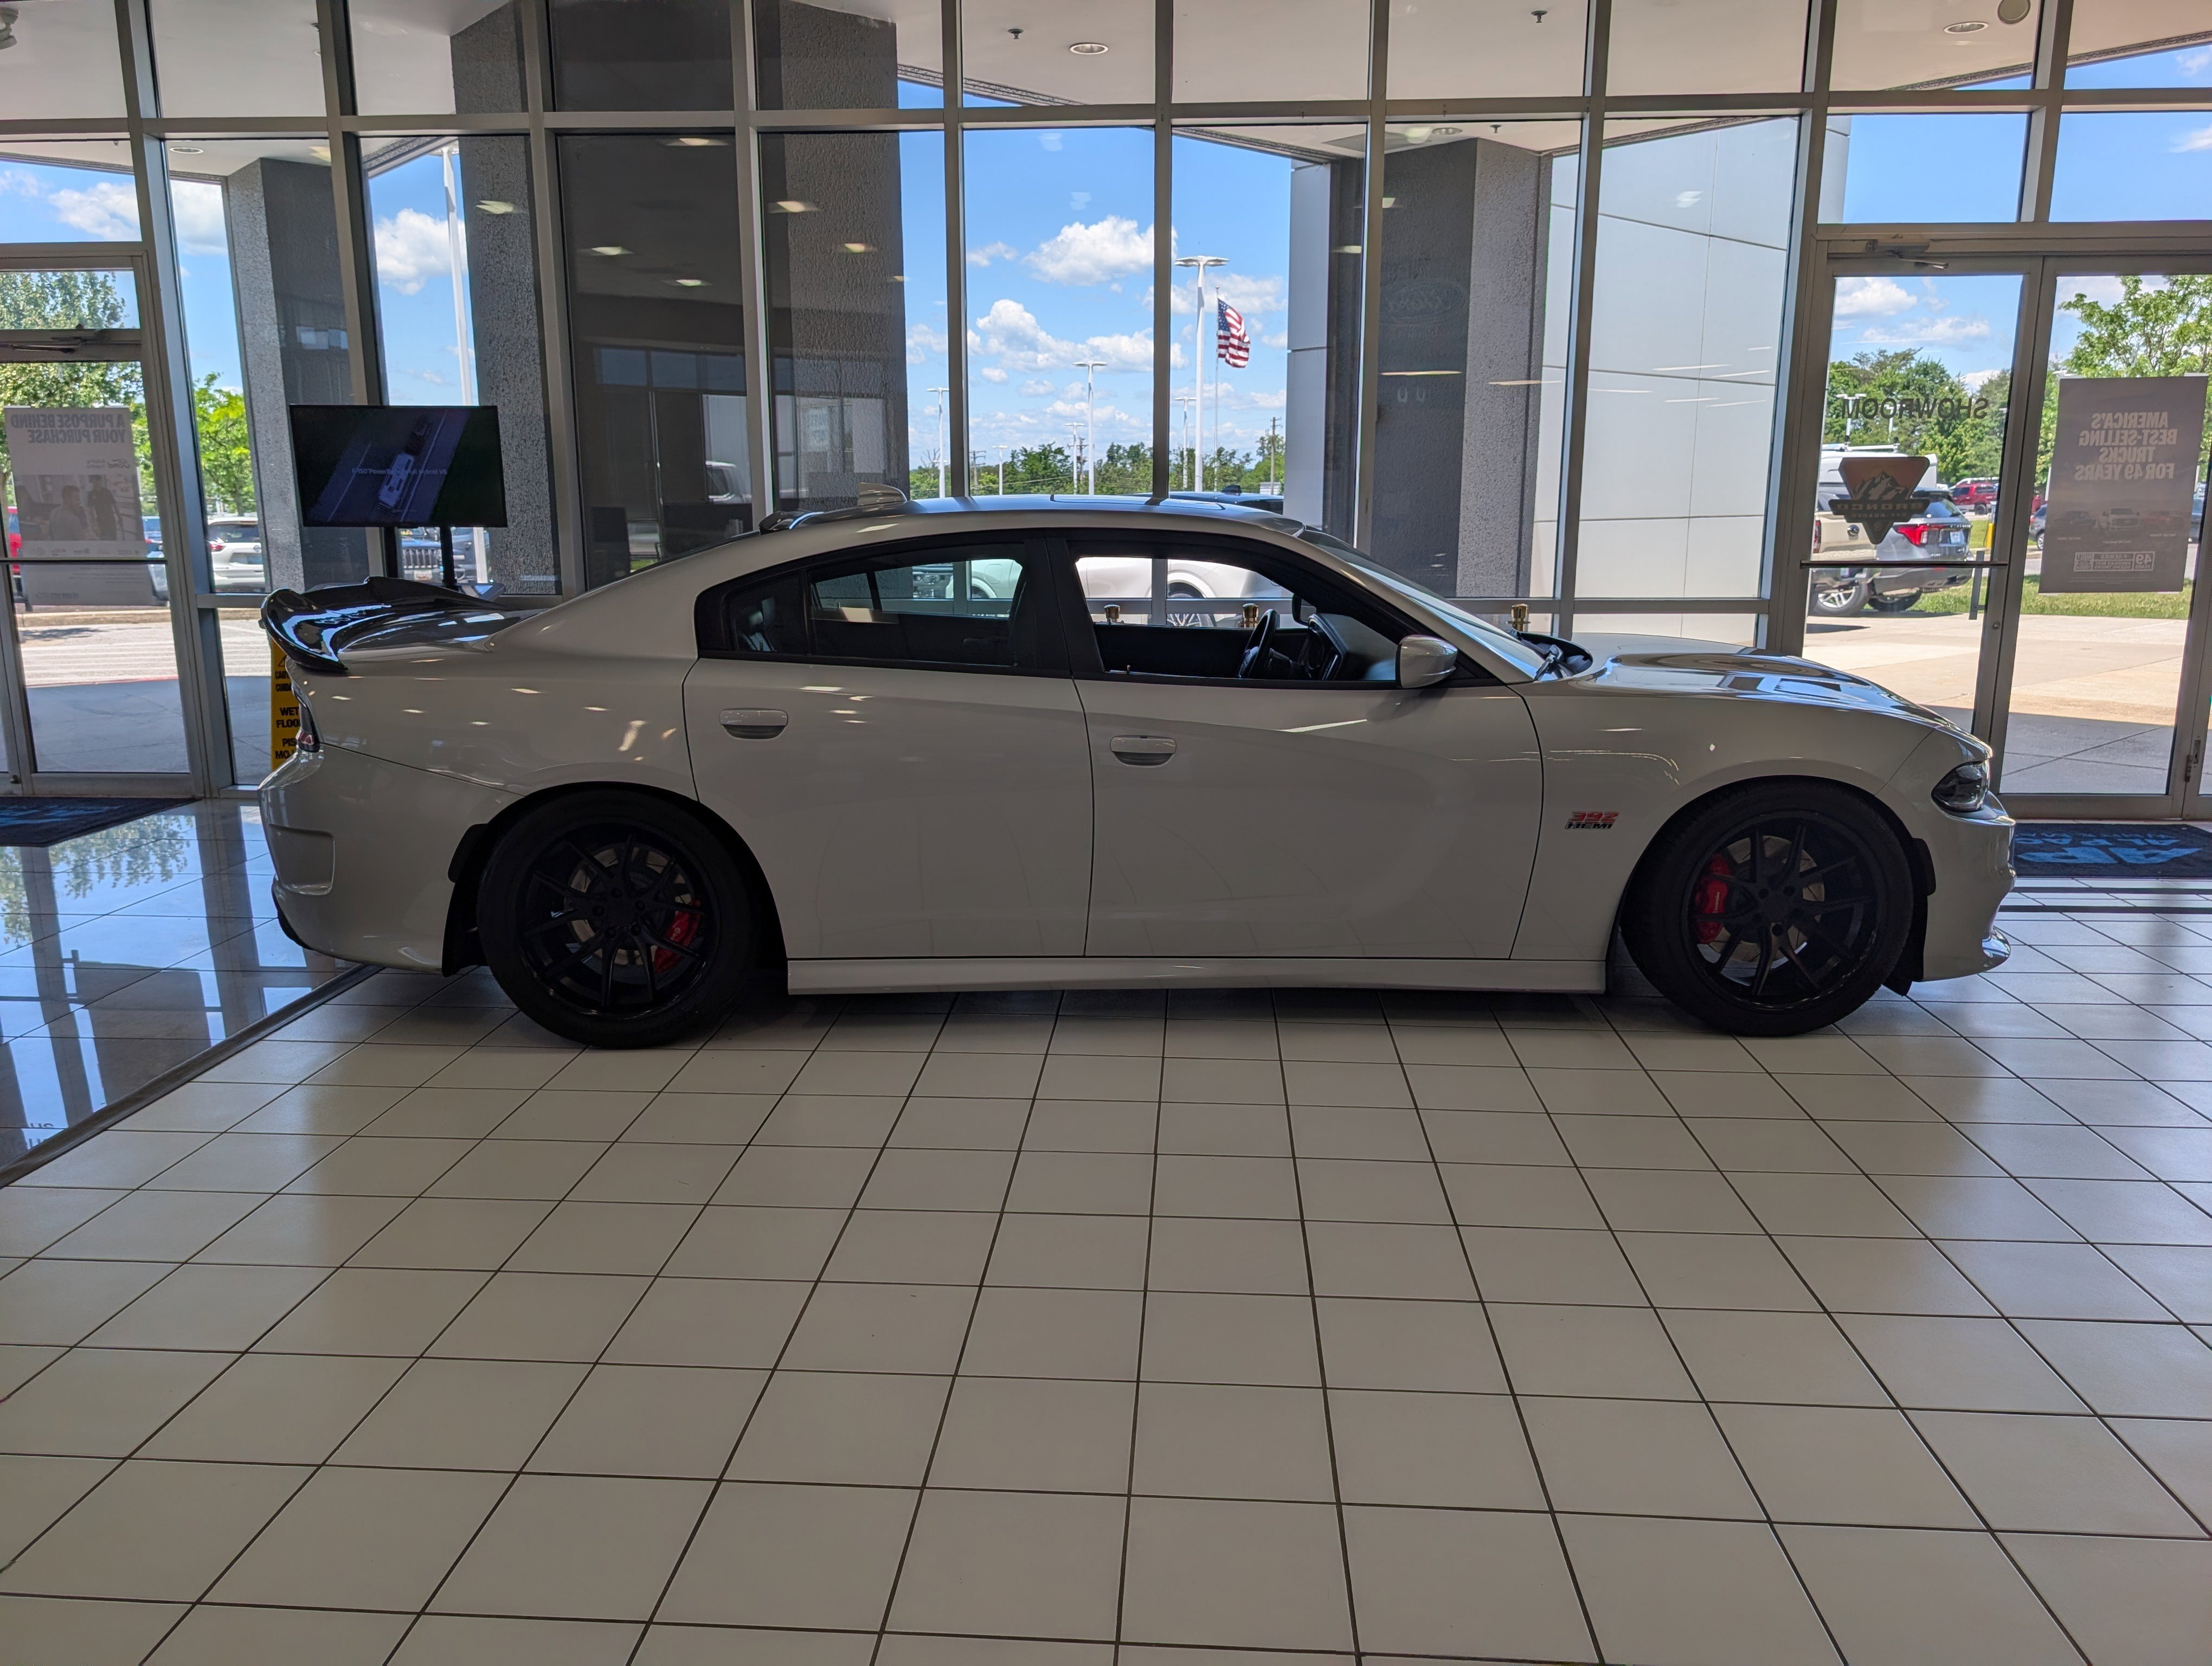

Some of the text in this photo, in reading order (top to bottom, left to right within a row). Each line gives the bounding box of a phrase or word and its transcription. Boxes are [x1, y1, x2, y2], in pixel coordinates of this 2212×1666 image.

[280, 707, 299, 716] WET
[276, 719, 301, 728] FLOO
[282, 738, 297, 747] PIS
[1568, 811, 1619, 822] 392
[1565, 822, 1613, 830] HEMI
